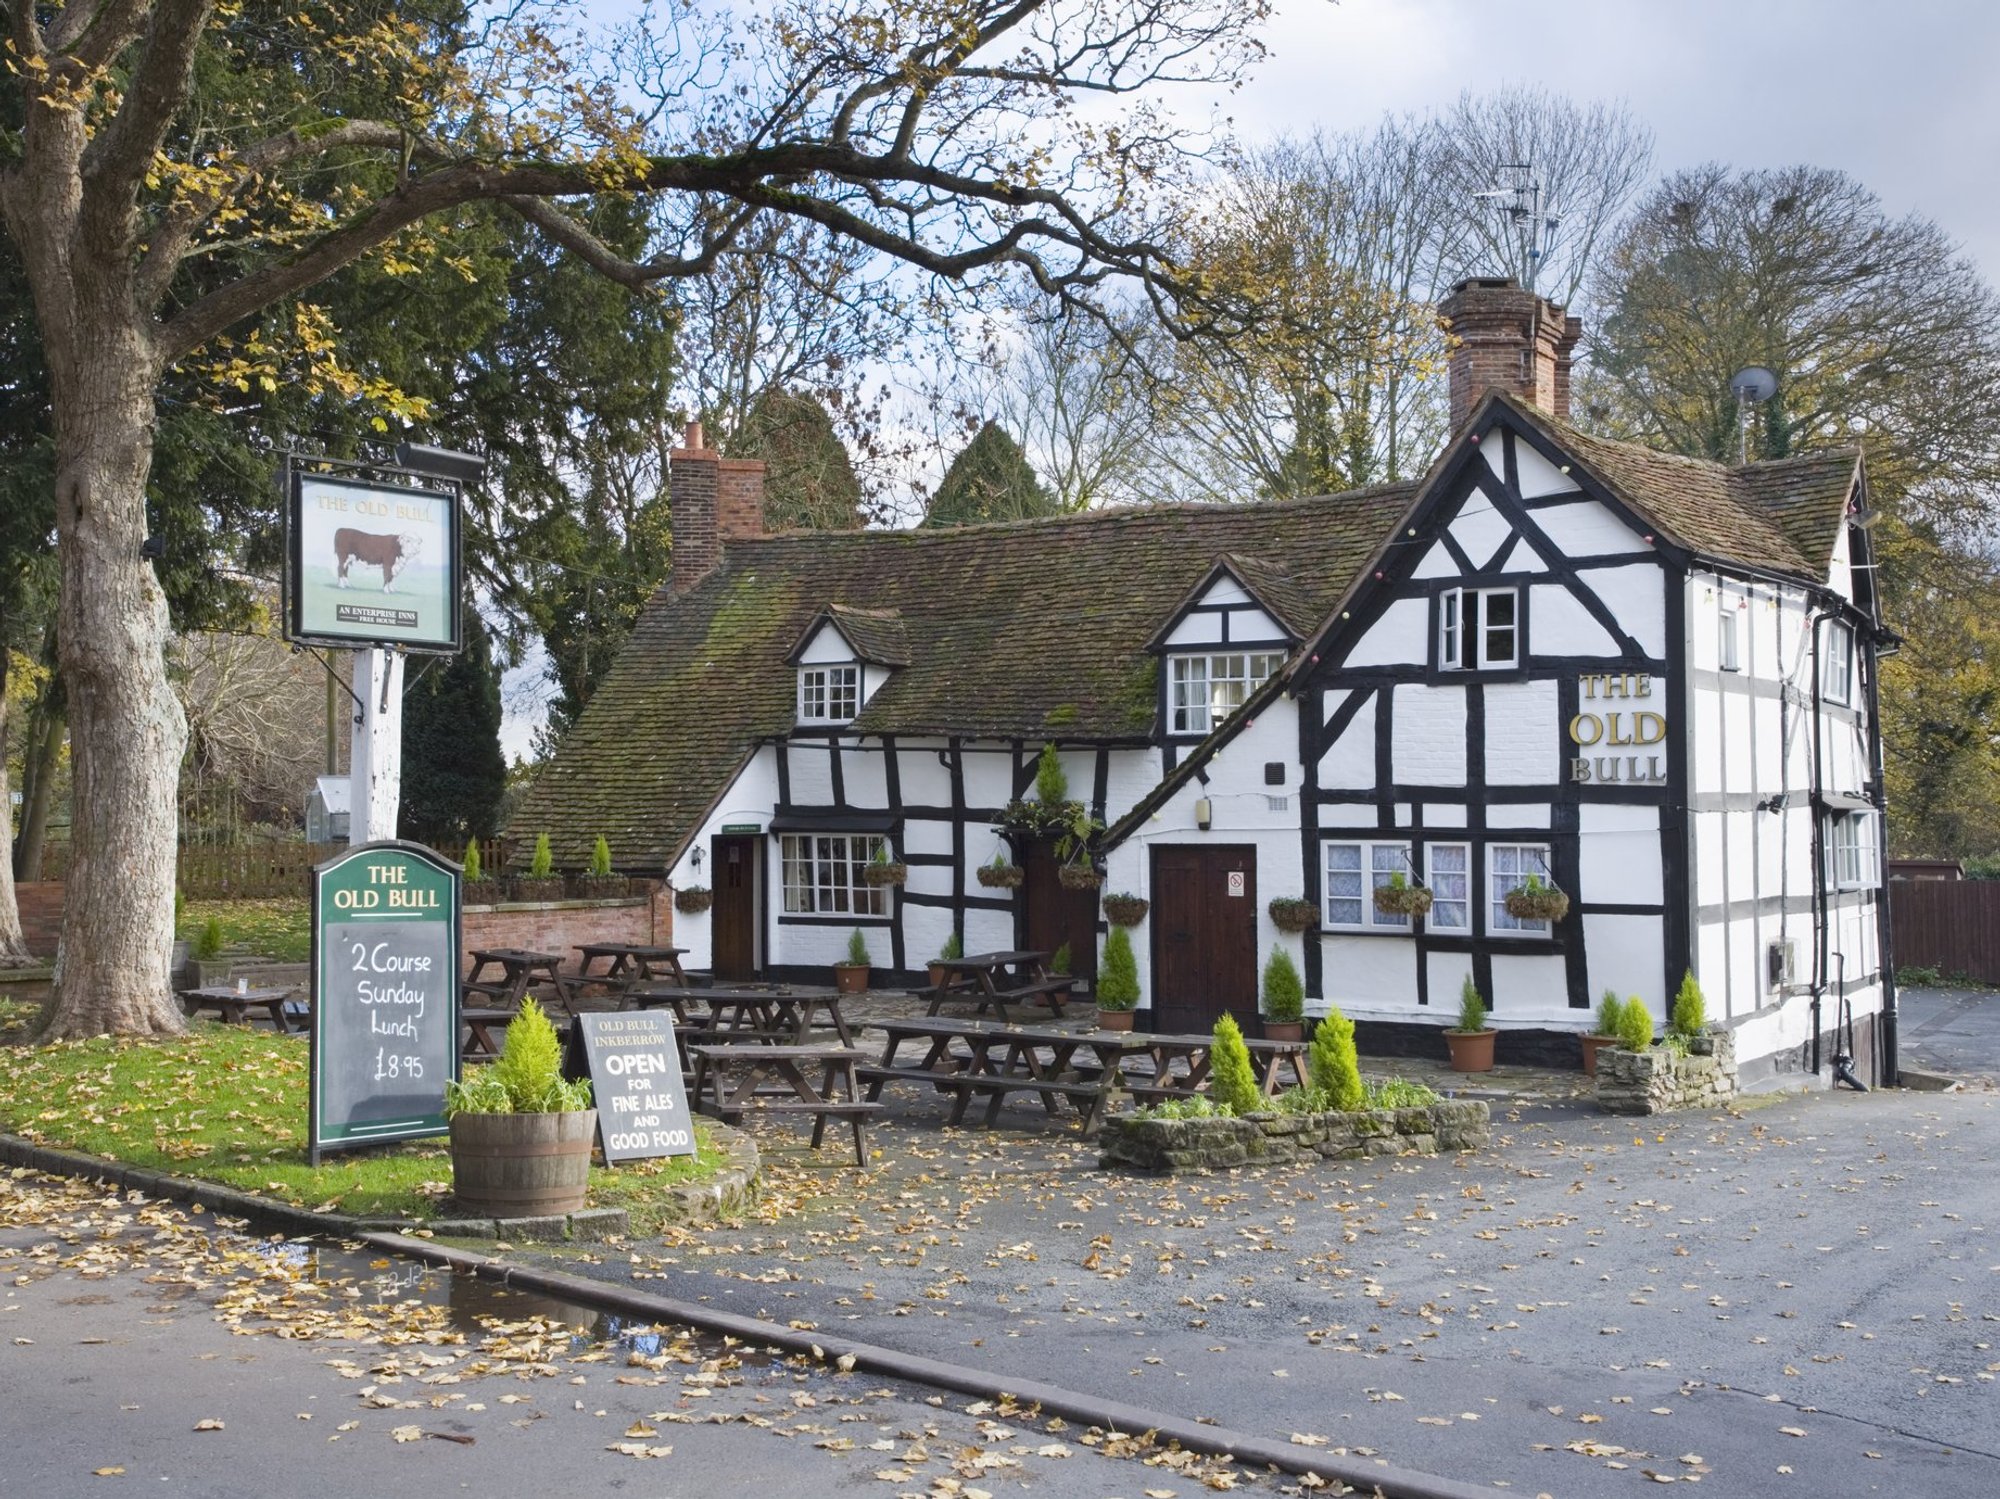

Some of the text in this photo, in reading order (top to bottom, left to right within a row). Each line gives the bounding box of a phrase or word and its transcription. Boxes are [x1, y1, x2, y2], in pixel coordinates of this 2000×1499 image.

[316, 495, 348, 512] THE
[355, 501, 389, 517] OLD
[339, 606, 416, 620] AN ENTERPRISE INNS
[359, 615, 375, 623] FREE
[1579, 673, 1652, 699] THE
[1569, 712, 1667, 746] OLD
[1569, 756, 1666, 782] BULL
[368, 866, 408, 884] THE
[334, 889, 440, 909] OLD BULL
[352, 943, 431, 973] 2 Course
[357, 980, 425, 1018] Sunday
[372, 1010, 418, 1042] Lunch
[599, 1020, 658, 1032] OLD BULL
[595, 1034, 666, 1047] INKBERROW
[606, 1053, 666, 1075] OPEN
[628, 1079, 652, 1090] FOR
[611, 1094, 674, 1112] FINE ALES
[633, 1115, 660, 1128] AND
[610, 1130, 688, 1150] GOOD FOOD
